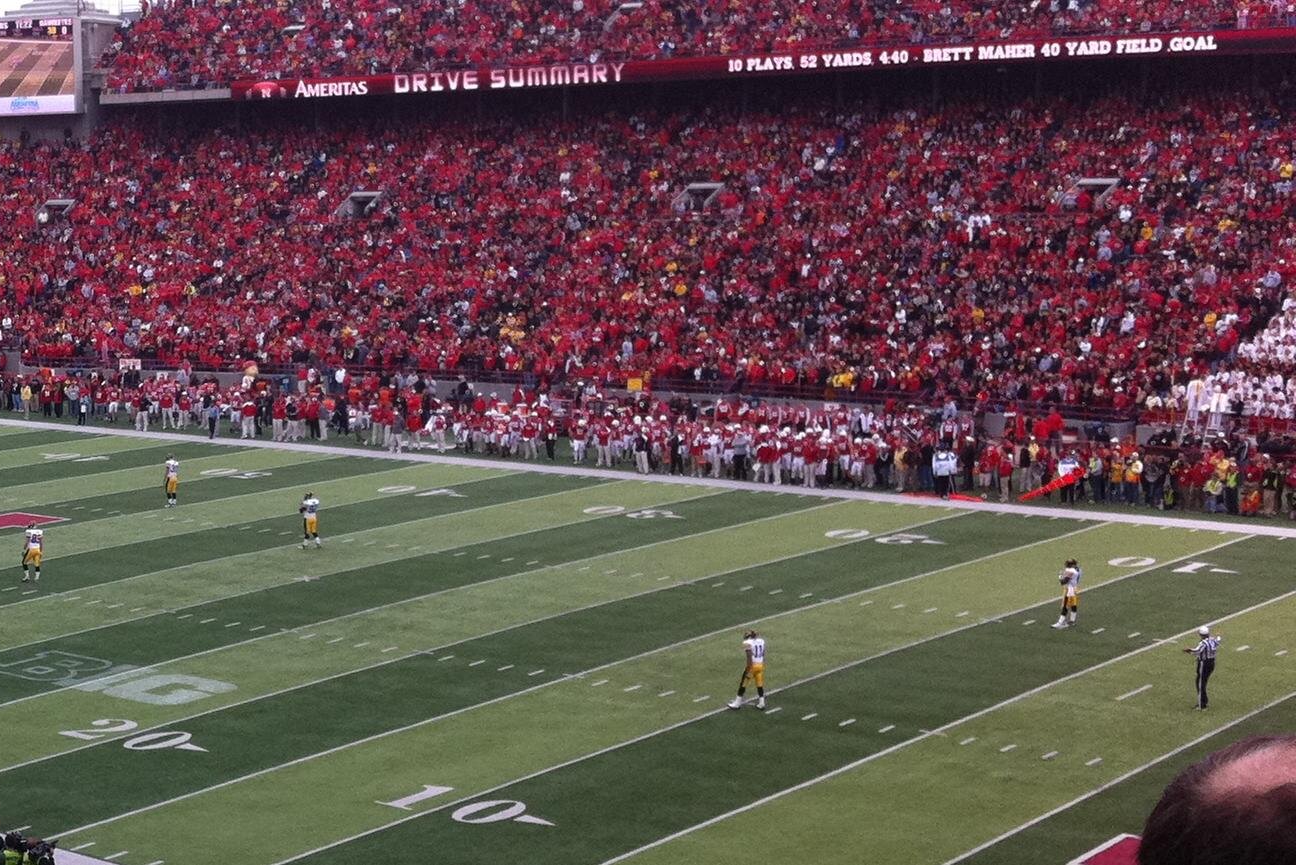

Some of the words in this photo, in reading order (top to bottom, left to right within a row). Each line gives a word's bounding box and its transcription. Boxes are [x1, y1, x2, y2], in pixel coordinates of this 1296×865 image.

[728, 59, 742, 72] 10
[800, 55, 817, 68] 52
[879, 51, 908, 64] 4:40
[923, 47, 973, 62] BRETT
[978, 44, 1035, 60] MAHER
[1041, 43, 1060, 57] 40
[1066, 41, 1111, 56] YARD
[1116, 39, 1162, 54] FIELD
[394, 74, 478, 93] DRIVE
[490, 63, 625, 88] SUMMARY
[57, 717, 194, 752] 20
[375, 784, 527, 824] 10
